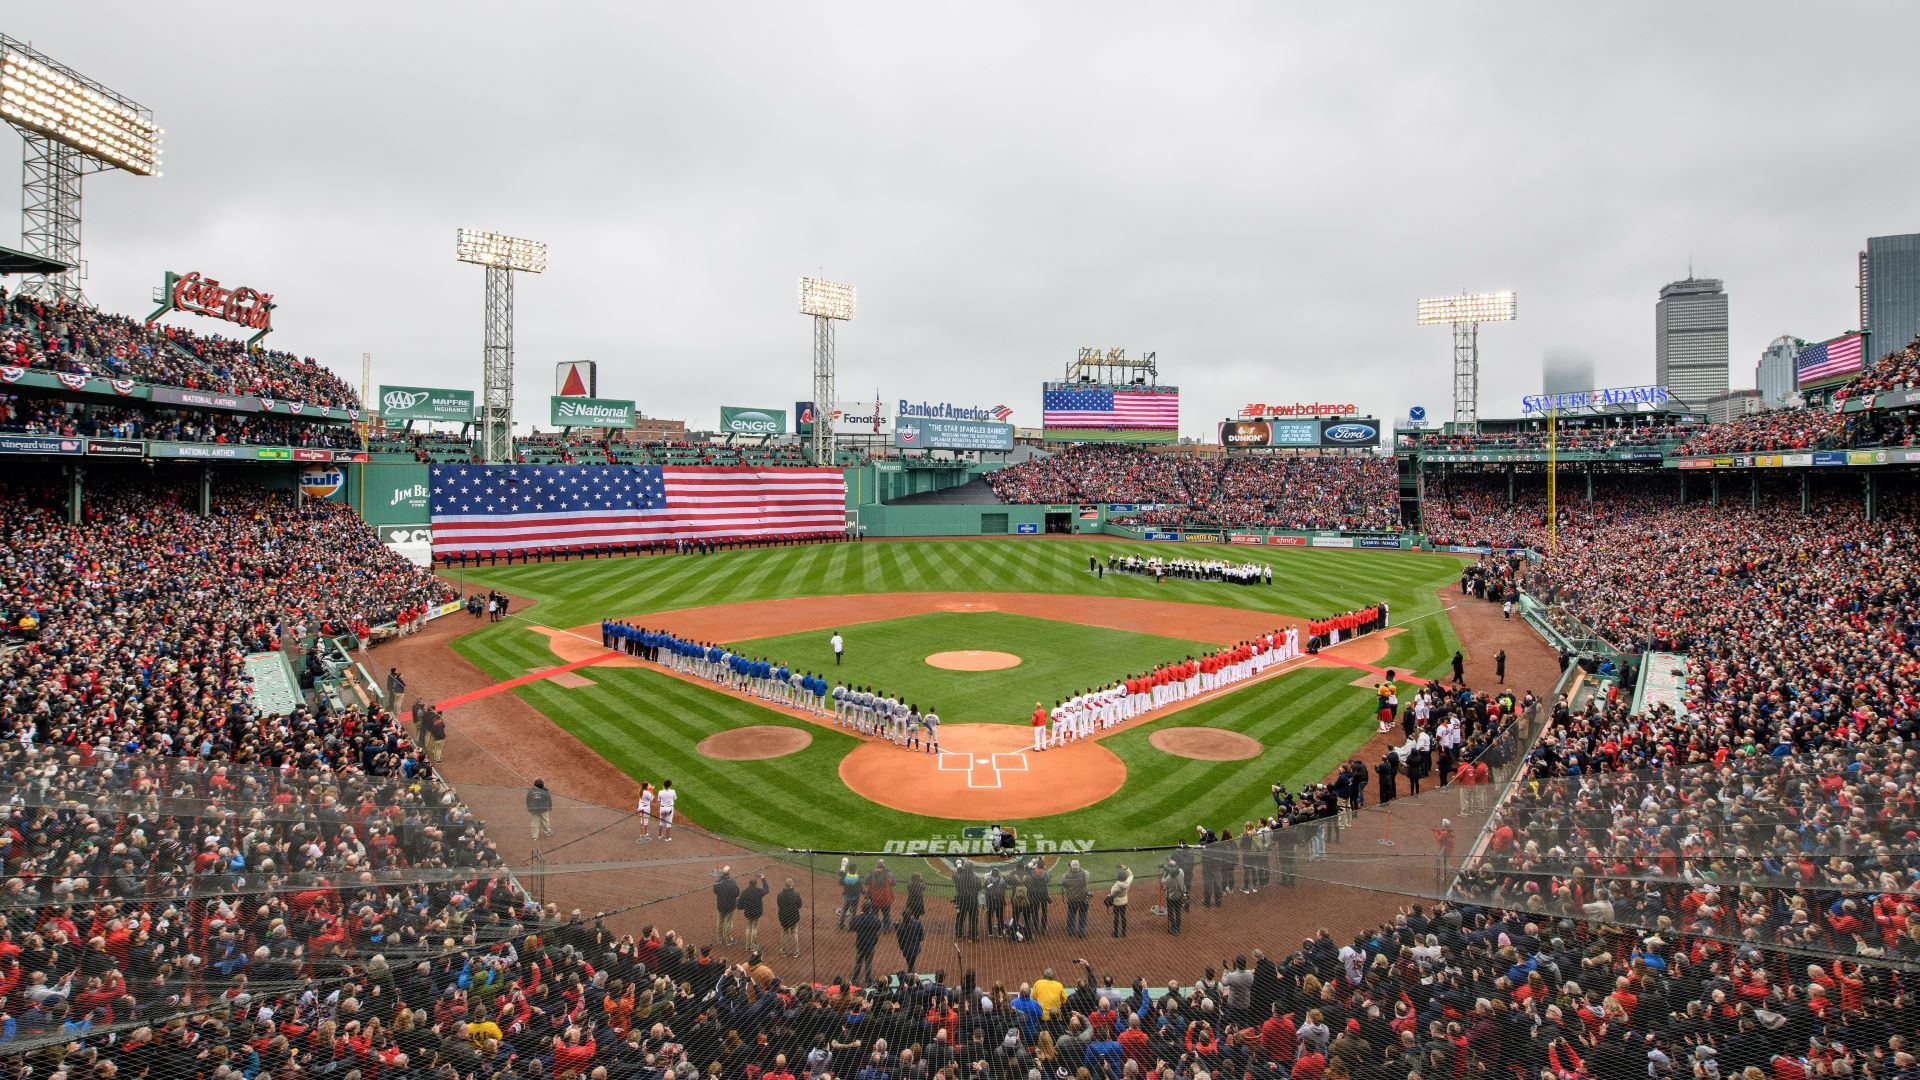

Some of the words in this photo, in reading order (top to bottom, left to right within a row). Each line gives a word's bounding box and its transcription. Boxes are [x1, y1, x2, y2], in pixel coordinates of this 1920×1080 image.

[182, 395, 212, 405] NATIONAL
[214, 399, 237, 408] ANTHEM
[385, 392, 412, 408] AAA
[432, 398, 471, 406] MAPFRE
[1522, 393, 1587, 414] SAMUEL
[1601, 386, 1668, 404] ADAMS
[575, 404, 627, 418] National
[899, 399, 931, 416] Bank
[931, 402, 944, 417] of
[944, 403, 989, 420] America
[1267, 405, 1296, 416] new
[1296, 402, 1356, 416] balance
[844, 413, 887, 424] Fanatis
[1229, 434, 1262, 442] DUNKIN'
[1335, 427, 1365, 439] Ford
[1, 441, 38, 451] vineyard
[38, 442, 60, 450] vines
[179, 447, 208, 457] NATIONAL
[391, 489, 412, 506] JIM
[414, 484, 430, 497] BE
[1276, 536, 1298, 544] xfinity
[1036, 839, 1097, 852] DAY
